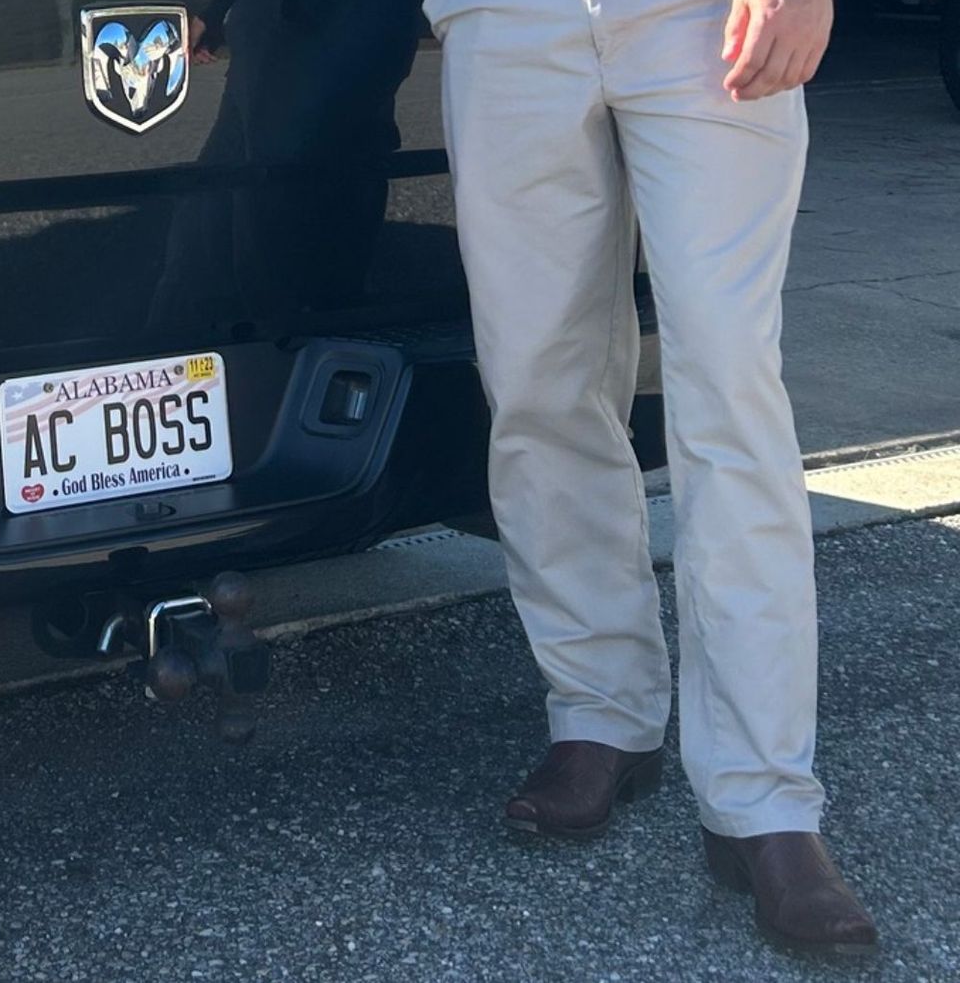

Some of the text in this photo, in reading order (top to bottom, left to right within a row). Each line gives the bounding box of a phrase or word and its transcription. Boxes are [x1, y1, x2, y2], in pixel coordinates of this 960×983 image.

[55, 368, 173, 403] ALABAMA
[24, 390, 212, 479] AC BOSS
[62, 477, 87, 497] God
[91, 470, 126, 492] Bless
[129, 462, 181, 485] America
